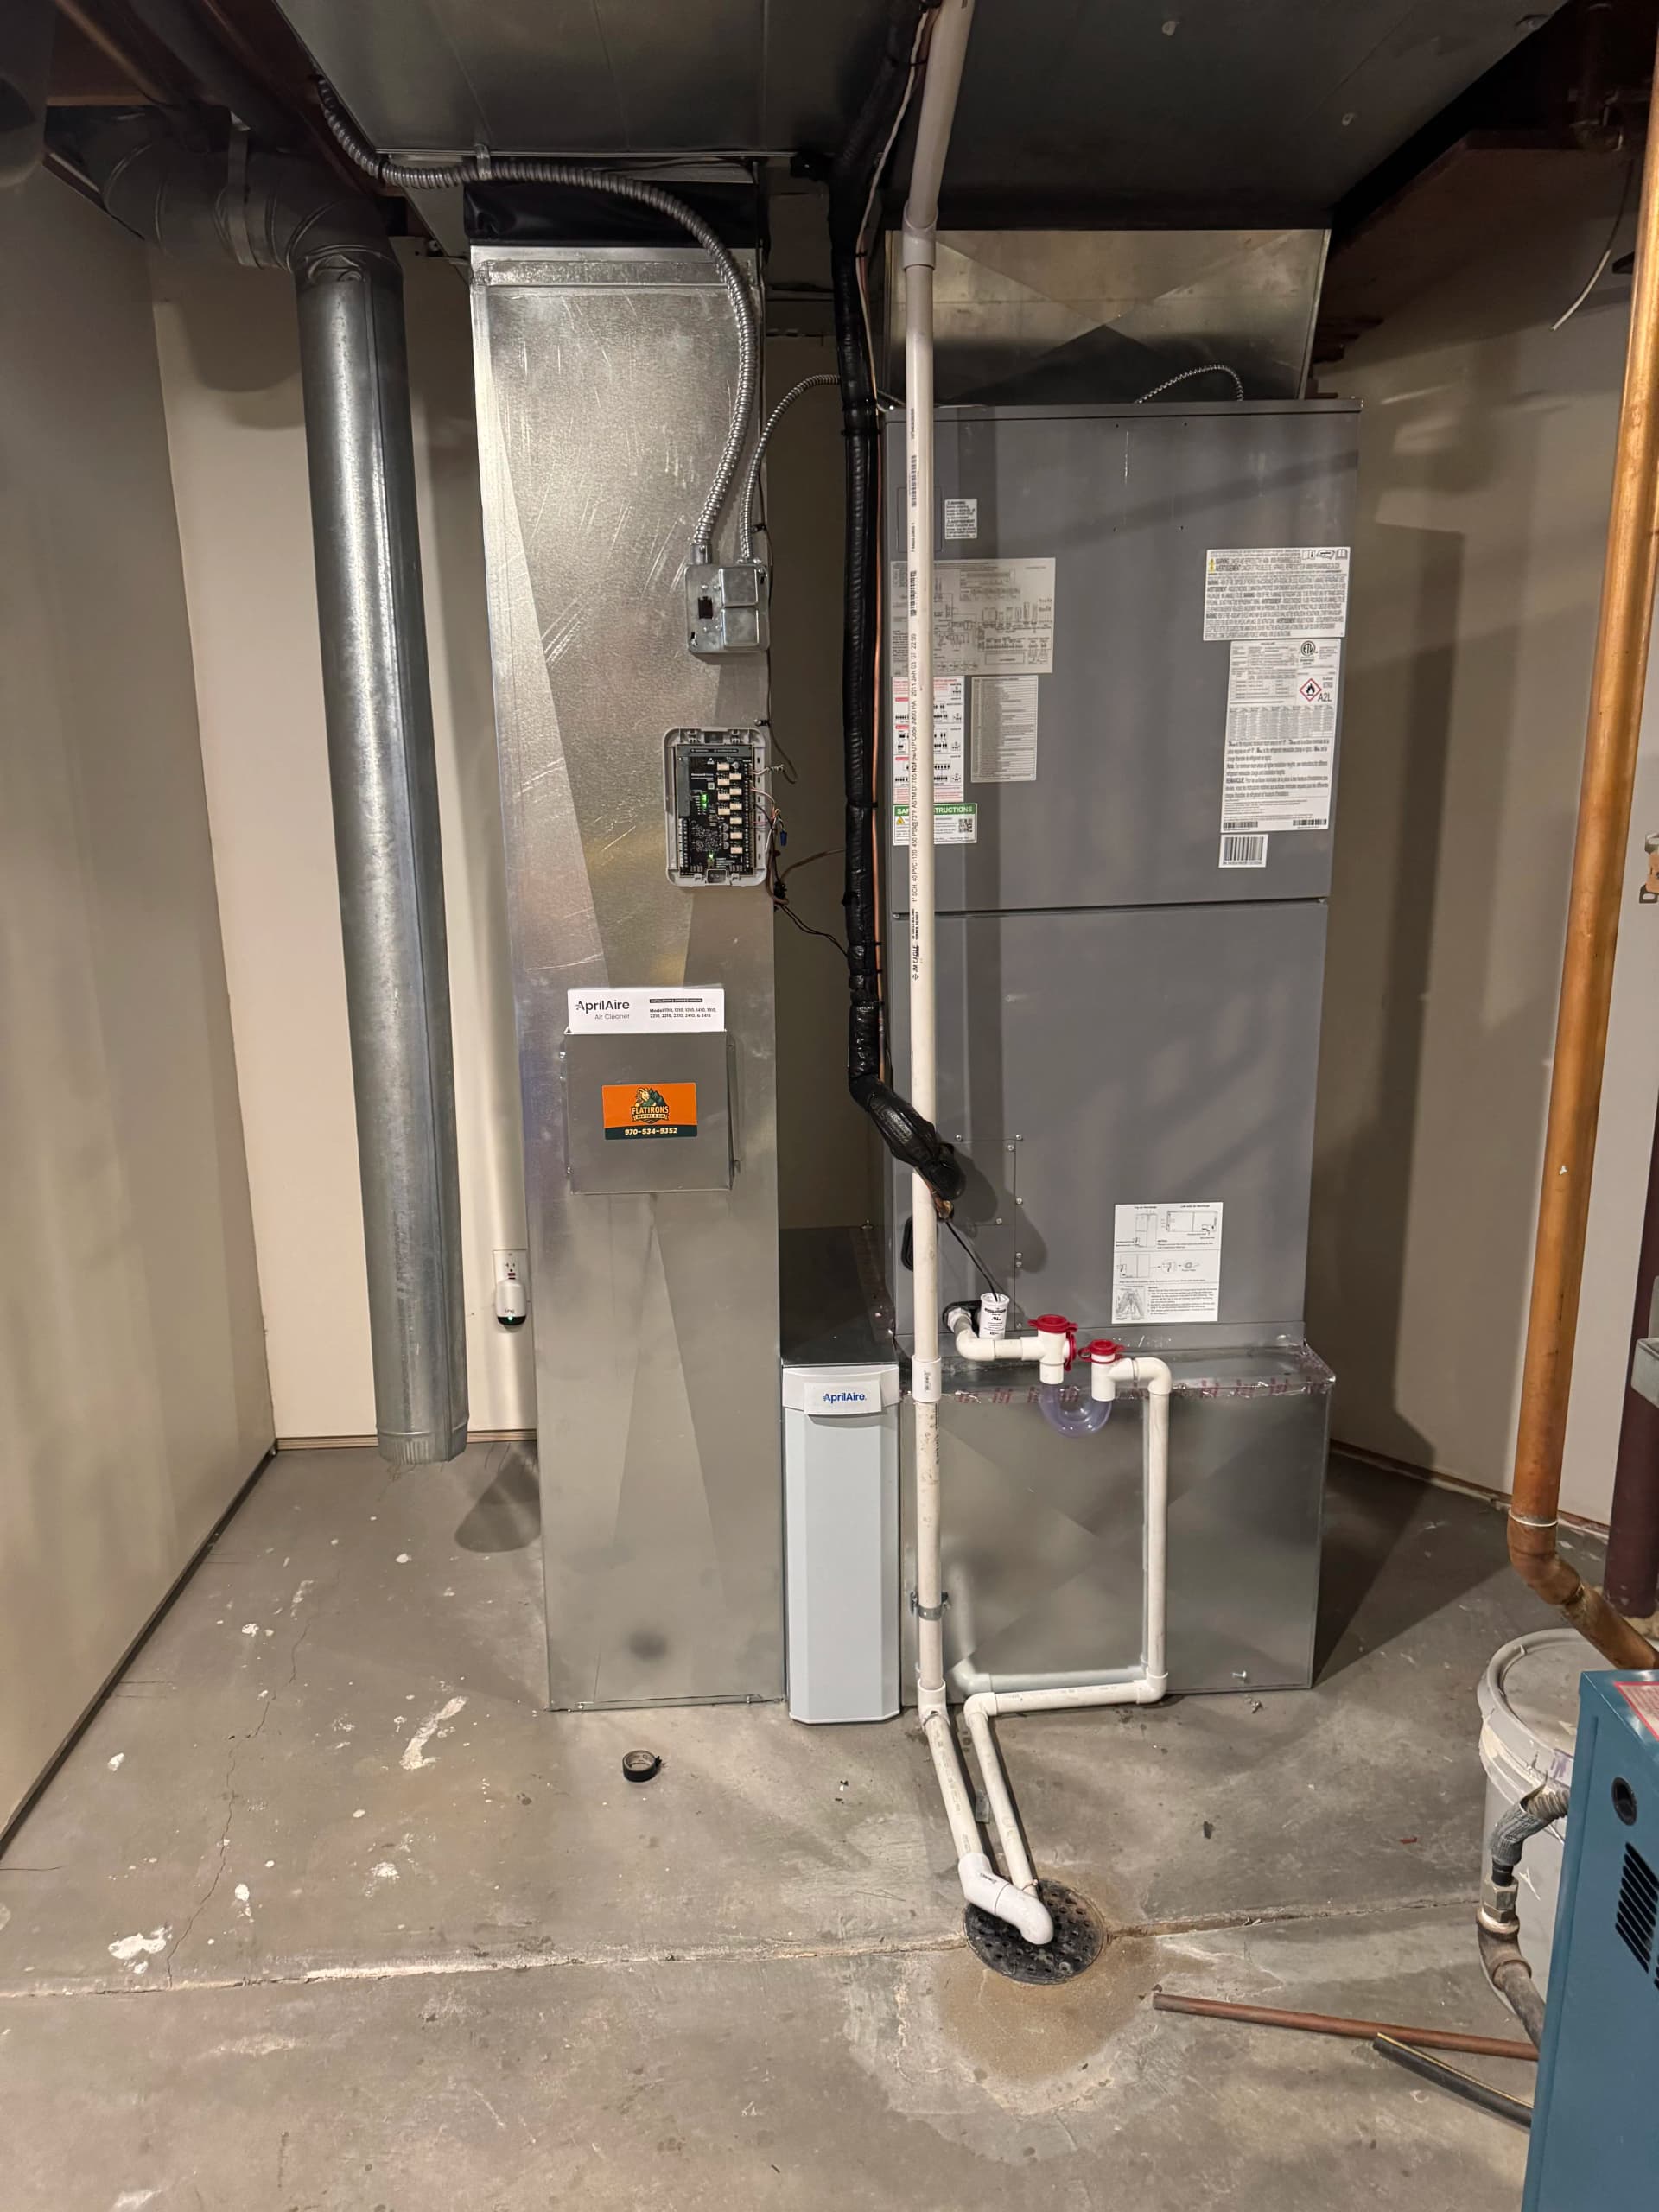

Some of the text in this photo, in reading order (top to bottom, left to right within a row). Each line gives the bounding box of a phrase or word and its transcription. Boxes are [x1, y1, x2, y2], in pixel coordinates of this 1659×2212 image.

[1318, 692, 1332, 702] A2L
[912, 964, 918, 973] JM
[575, 999, 630, 1014] AprilAire
[632, 1106, 669, 1115] FLATIRONS
[823, 1392, 866, 1403] AprilAire
